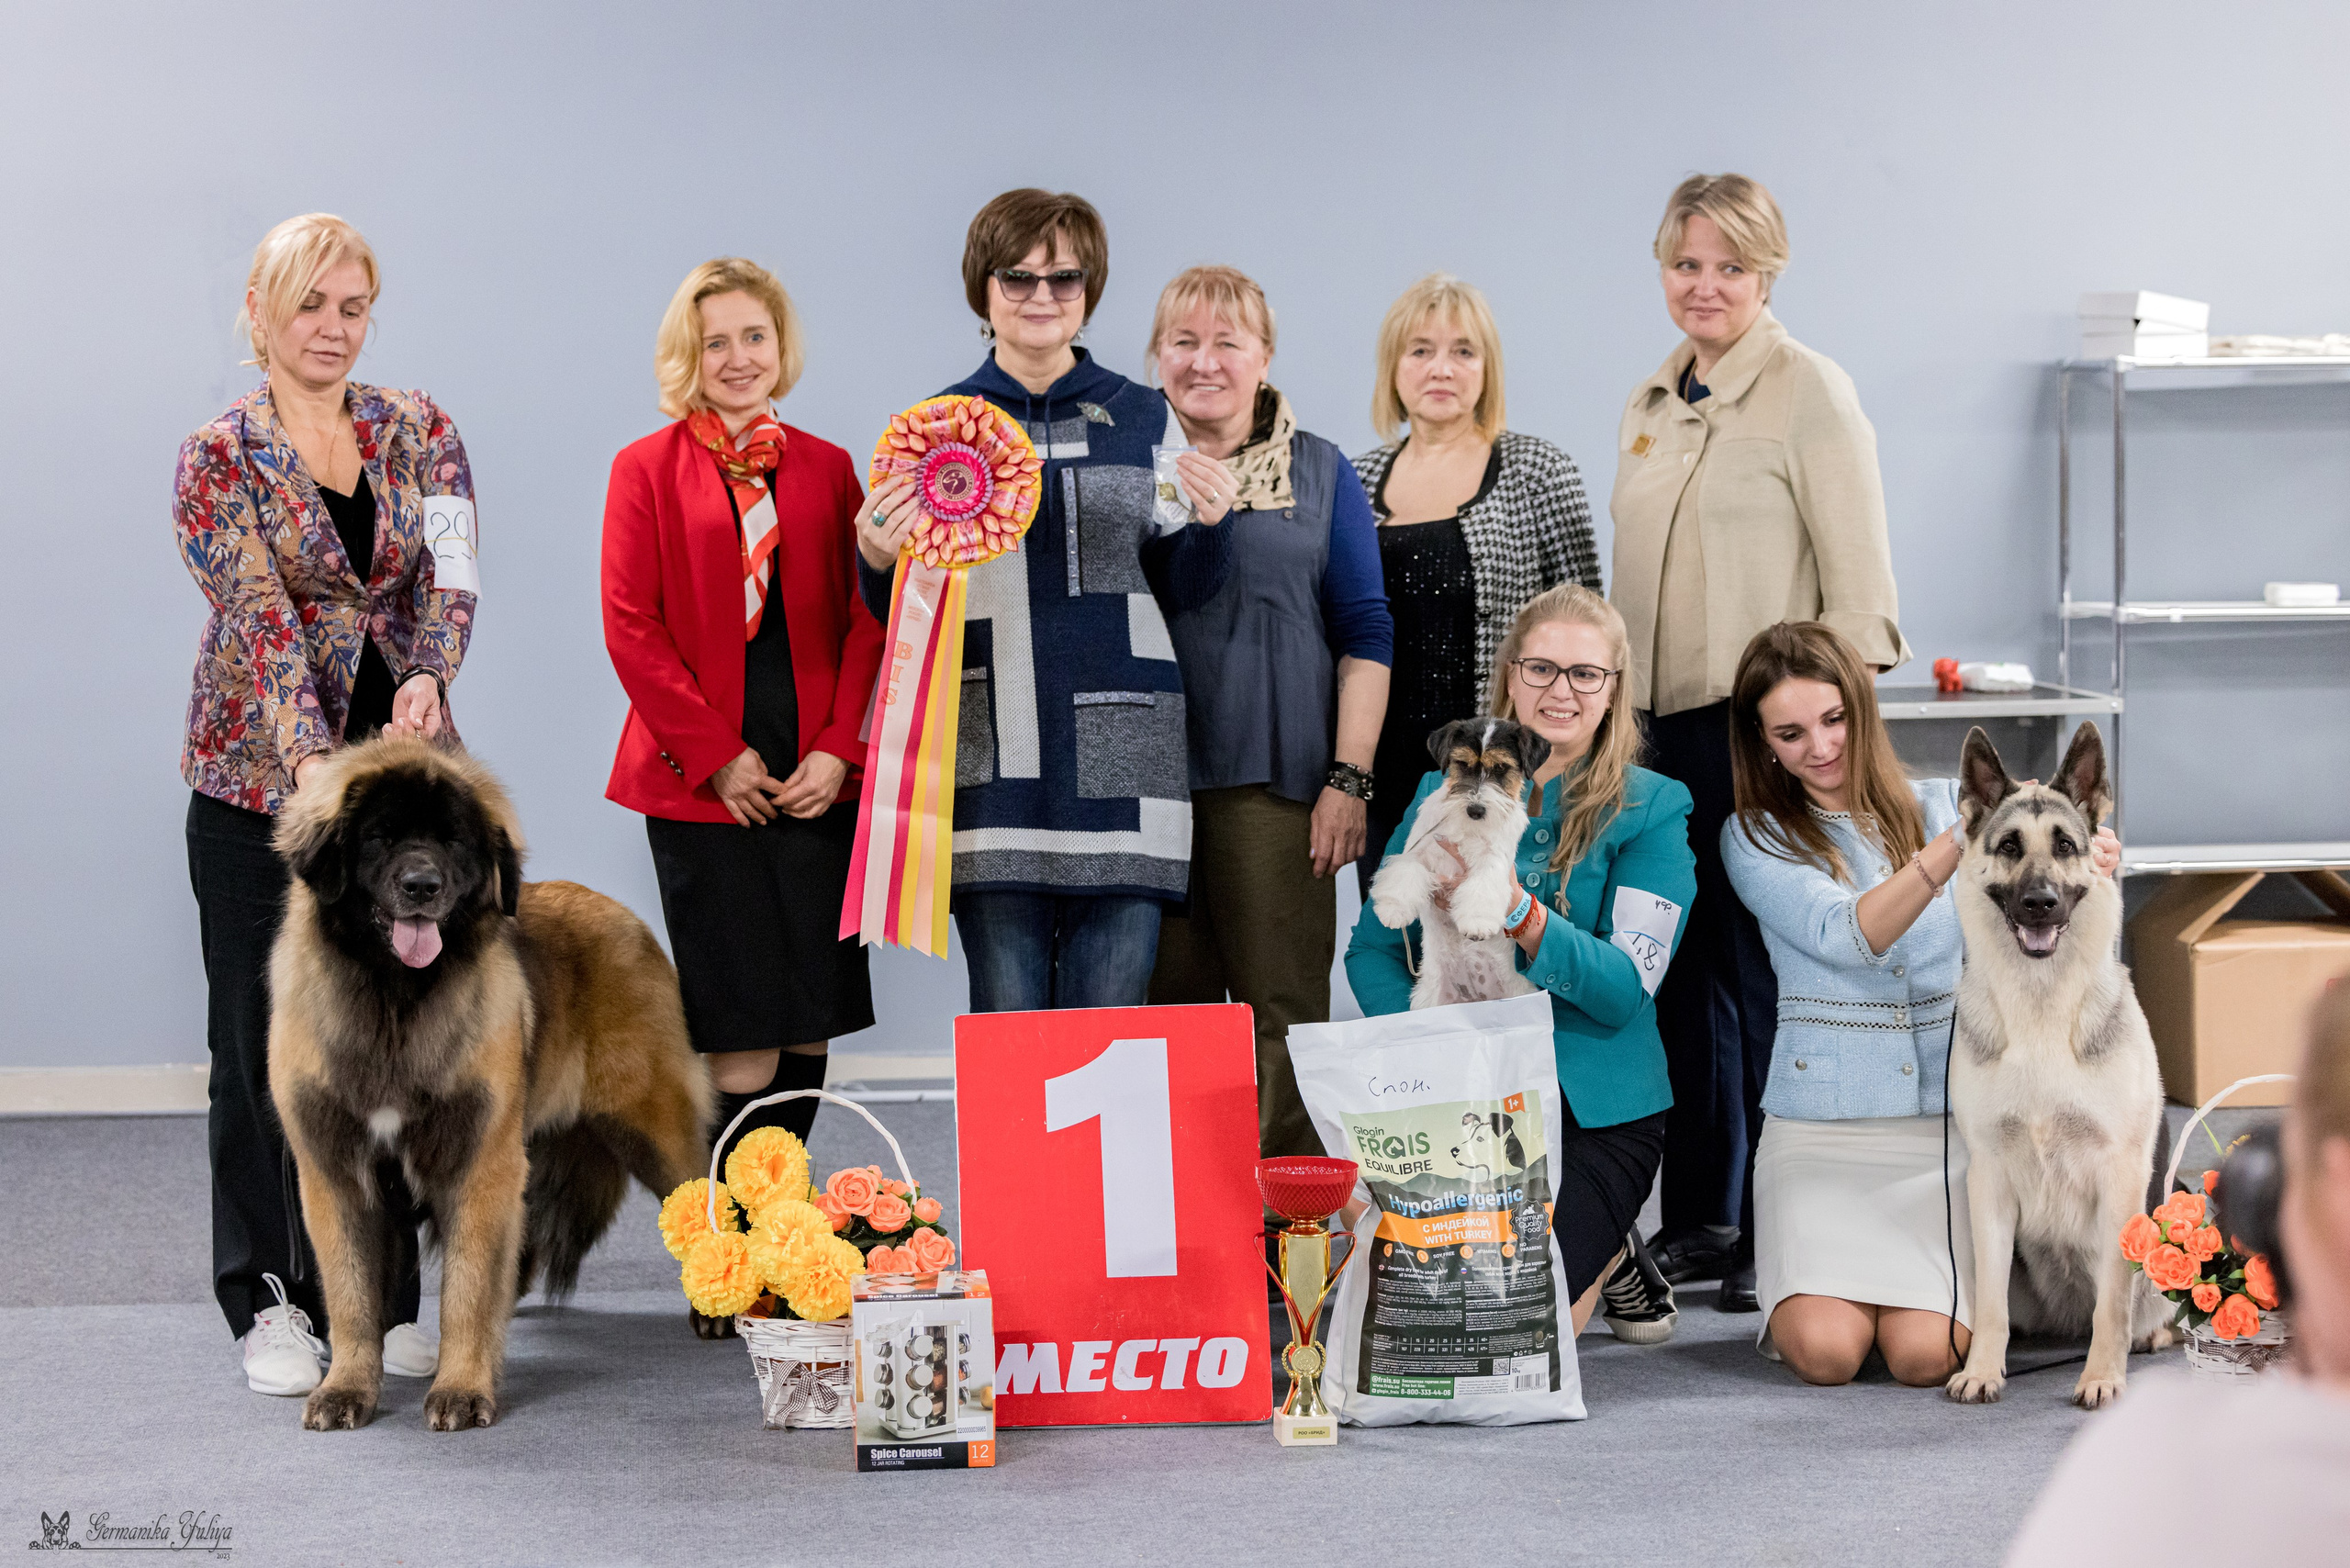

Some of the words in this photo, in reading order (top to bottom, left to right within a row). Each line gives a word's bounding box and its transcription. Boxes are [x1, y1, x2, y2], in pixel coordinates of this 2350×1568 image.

[1353, 1126, 1385, 1137] Glogin
[1045, 1037, 1178, 1279] 1
[1364, 1159, 1434, 1176] EQUILIBRE
[1388, 1186, 1524, 1218] Hypoallergenic
[1432, 1215, 1490, 1233] ИНДЕЙКОЙ
[1515, 1214, 1544, 1223] Premium
[1518, 1221, 1543, 1231] Quality
[1424, 1236, 1453, 1245] WITH
[1456, 1230, 1493, 1241] TURKEY
[995, 1336, 1249, 1394] МЕСТО
[871, 1449, 897, 1460] Spice
[900, 1447, 942, 1457] Carousel
[972, 1444, 989, 1458] 12
